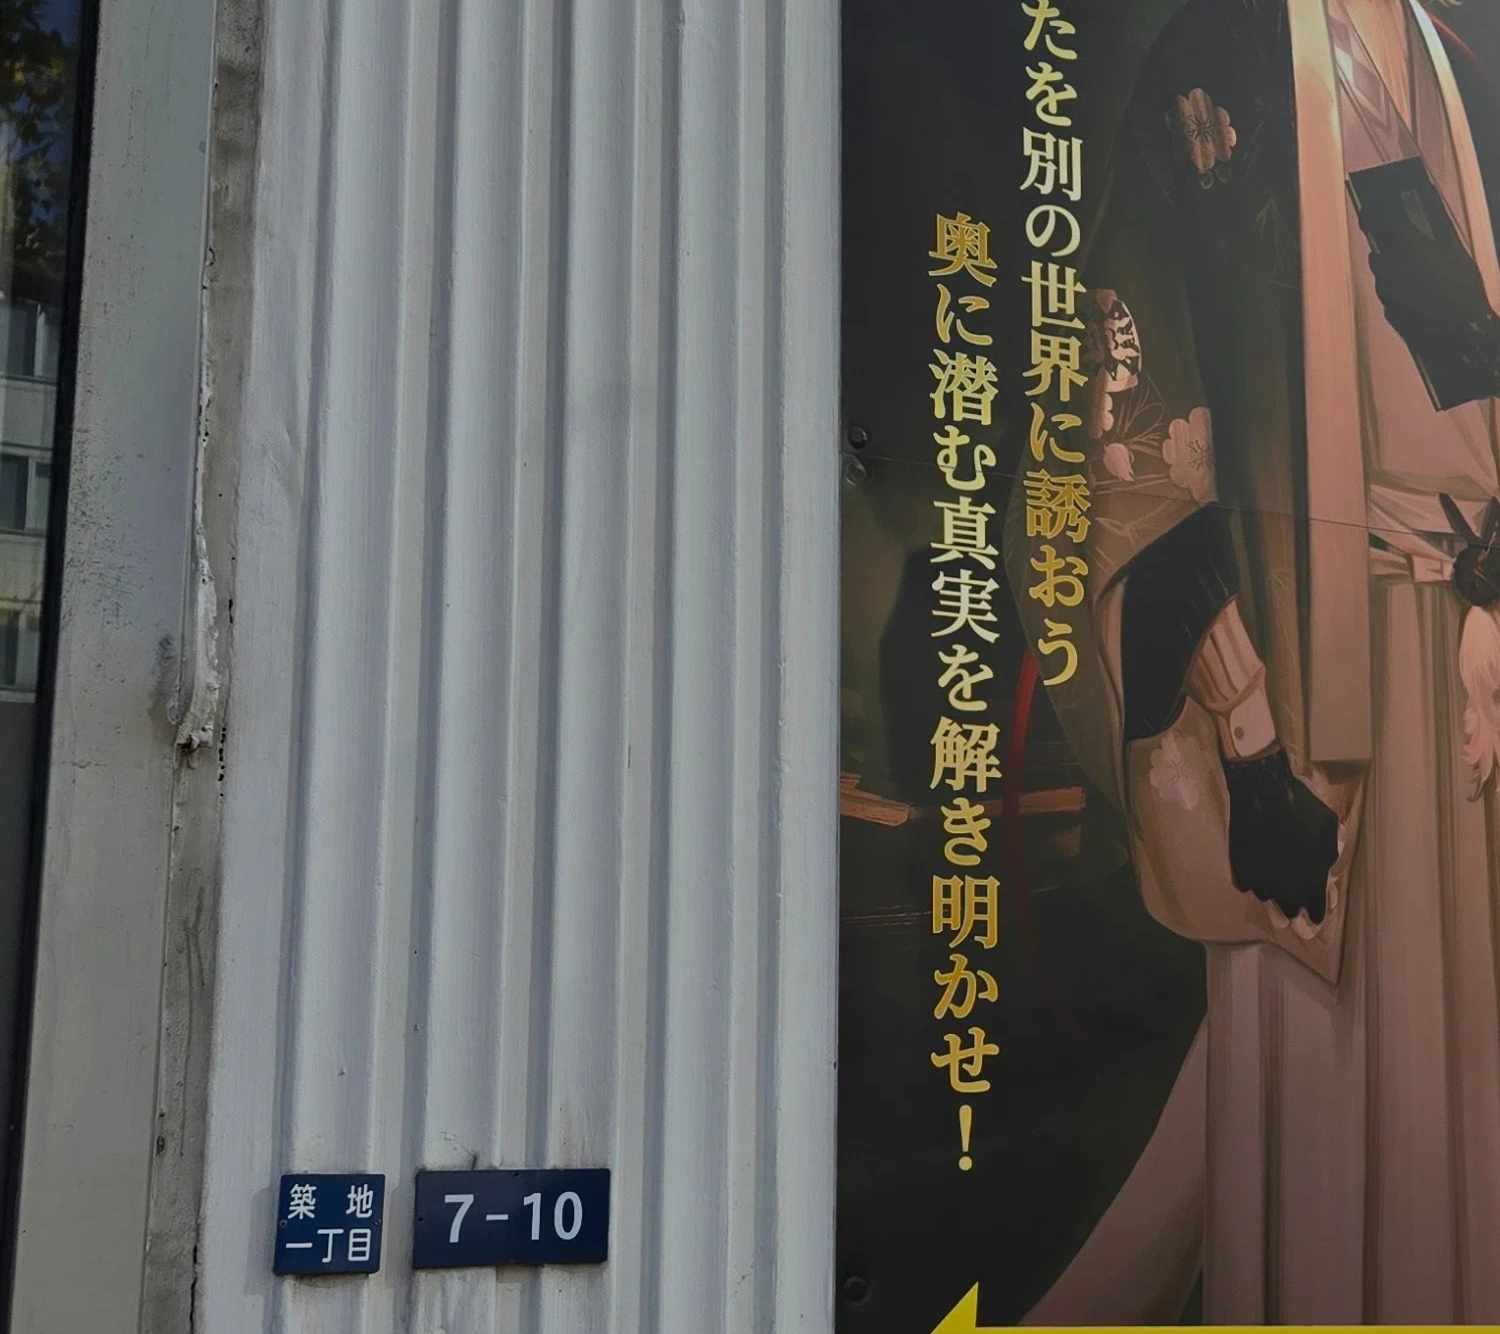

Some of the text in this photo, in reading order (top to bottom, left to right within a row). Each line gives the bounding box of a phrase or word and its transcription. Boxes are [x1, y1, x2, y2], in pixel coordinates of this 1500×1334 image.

[928, 211, 1002, 1171] 奥に潜む真実を解き明かせ!
[444, 1191, 583, 1244] 7-10
[285, 1228, 372, 1264] 一丁目
